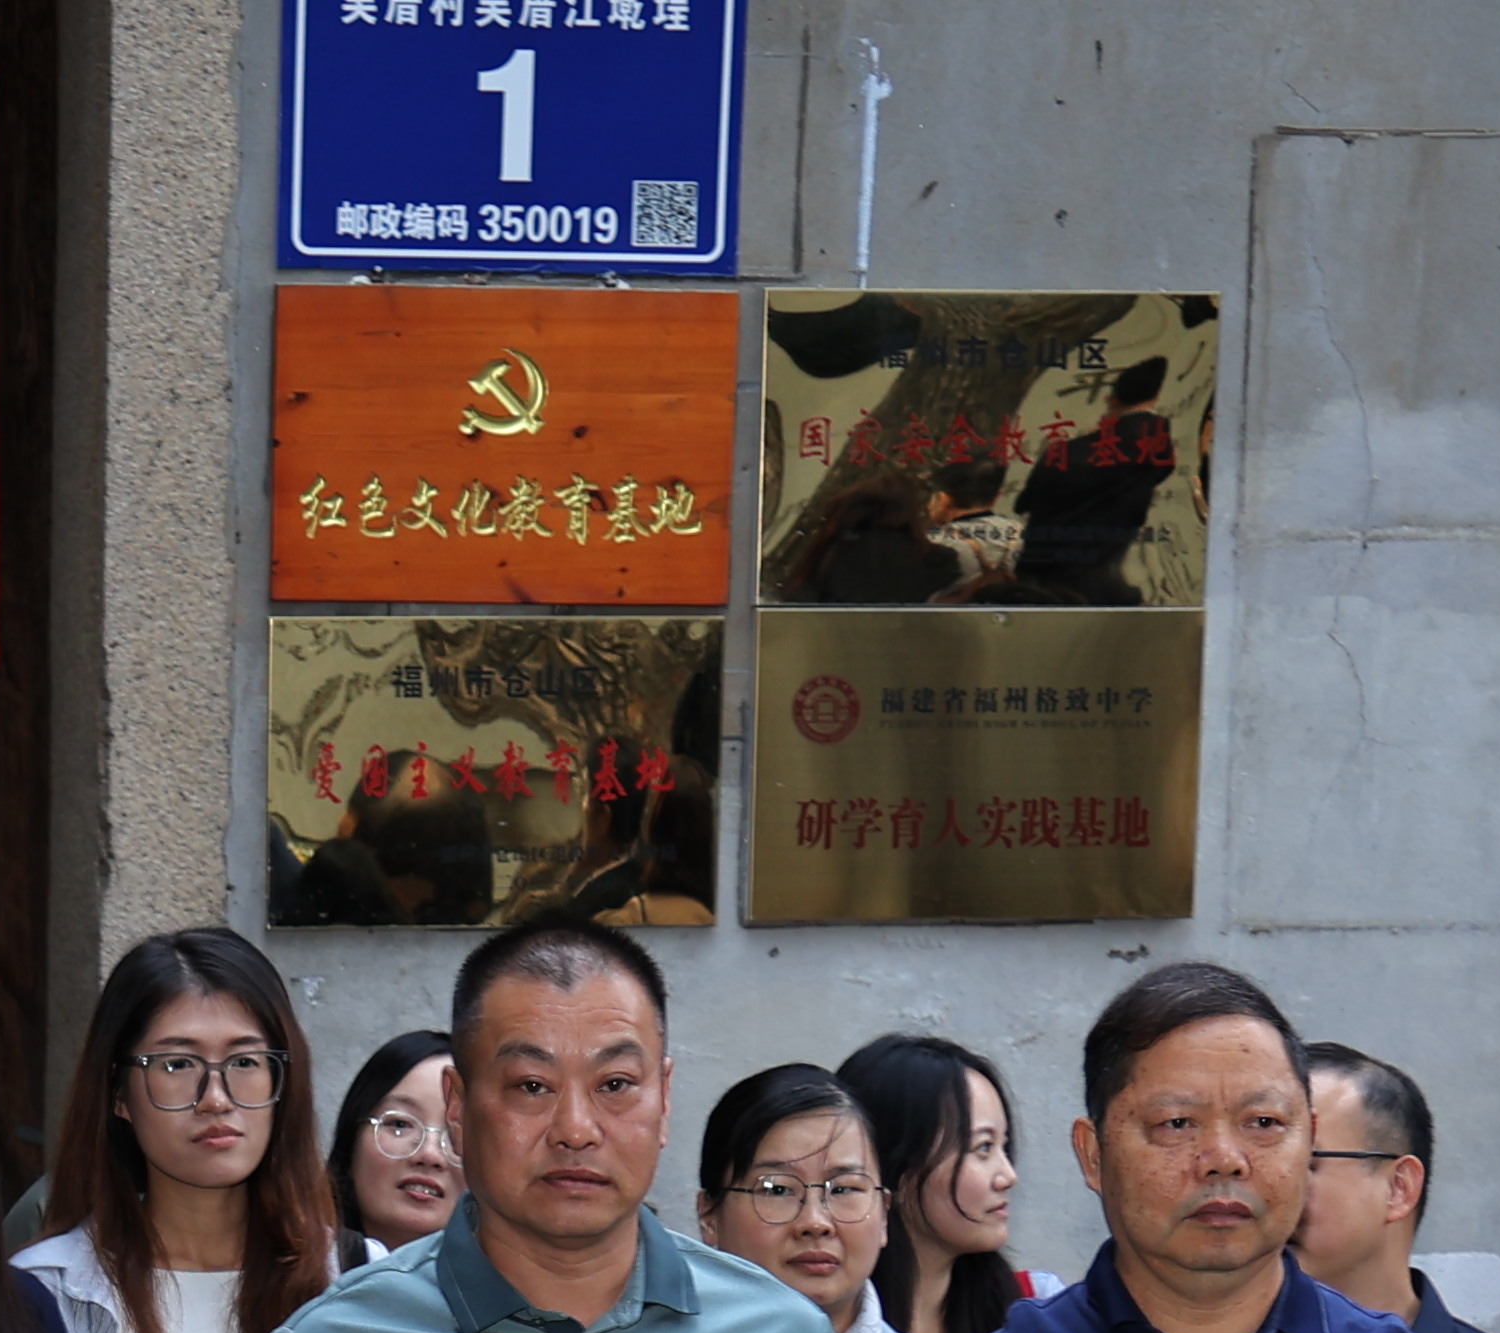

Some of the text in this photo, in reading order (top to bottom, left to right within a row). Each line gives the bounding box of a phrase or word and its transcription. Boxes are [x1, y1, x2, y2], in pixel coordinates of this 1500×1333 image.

[476, 49, 537, 182] 1
[336, 201, 620, 244] 邮政编码 350019
[880, 337, 1109, 371] 福州市仓山区
[799, 408, 1177, 472] 国家安全教育基地
[299, 476, 704, 544] 红色文化教育基地
[391, 665, 600, 699] 福州市仓山区
[880, 685, 1154, 714] 福建省福州格致中学
[796, 795, 1152, 851] 研学育人实践基地
